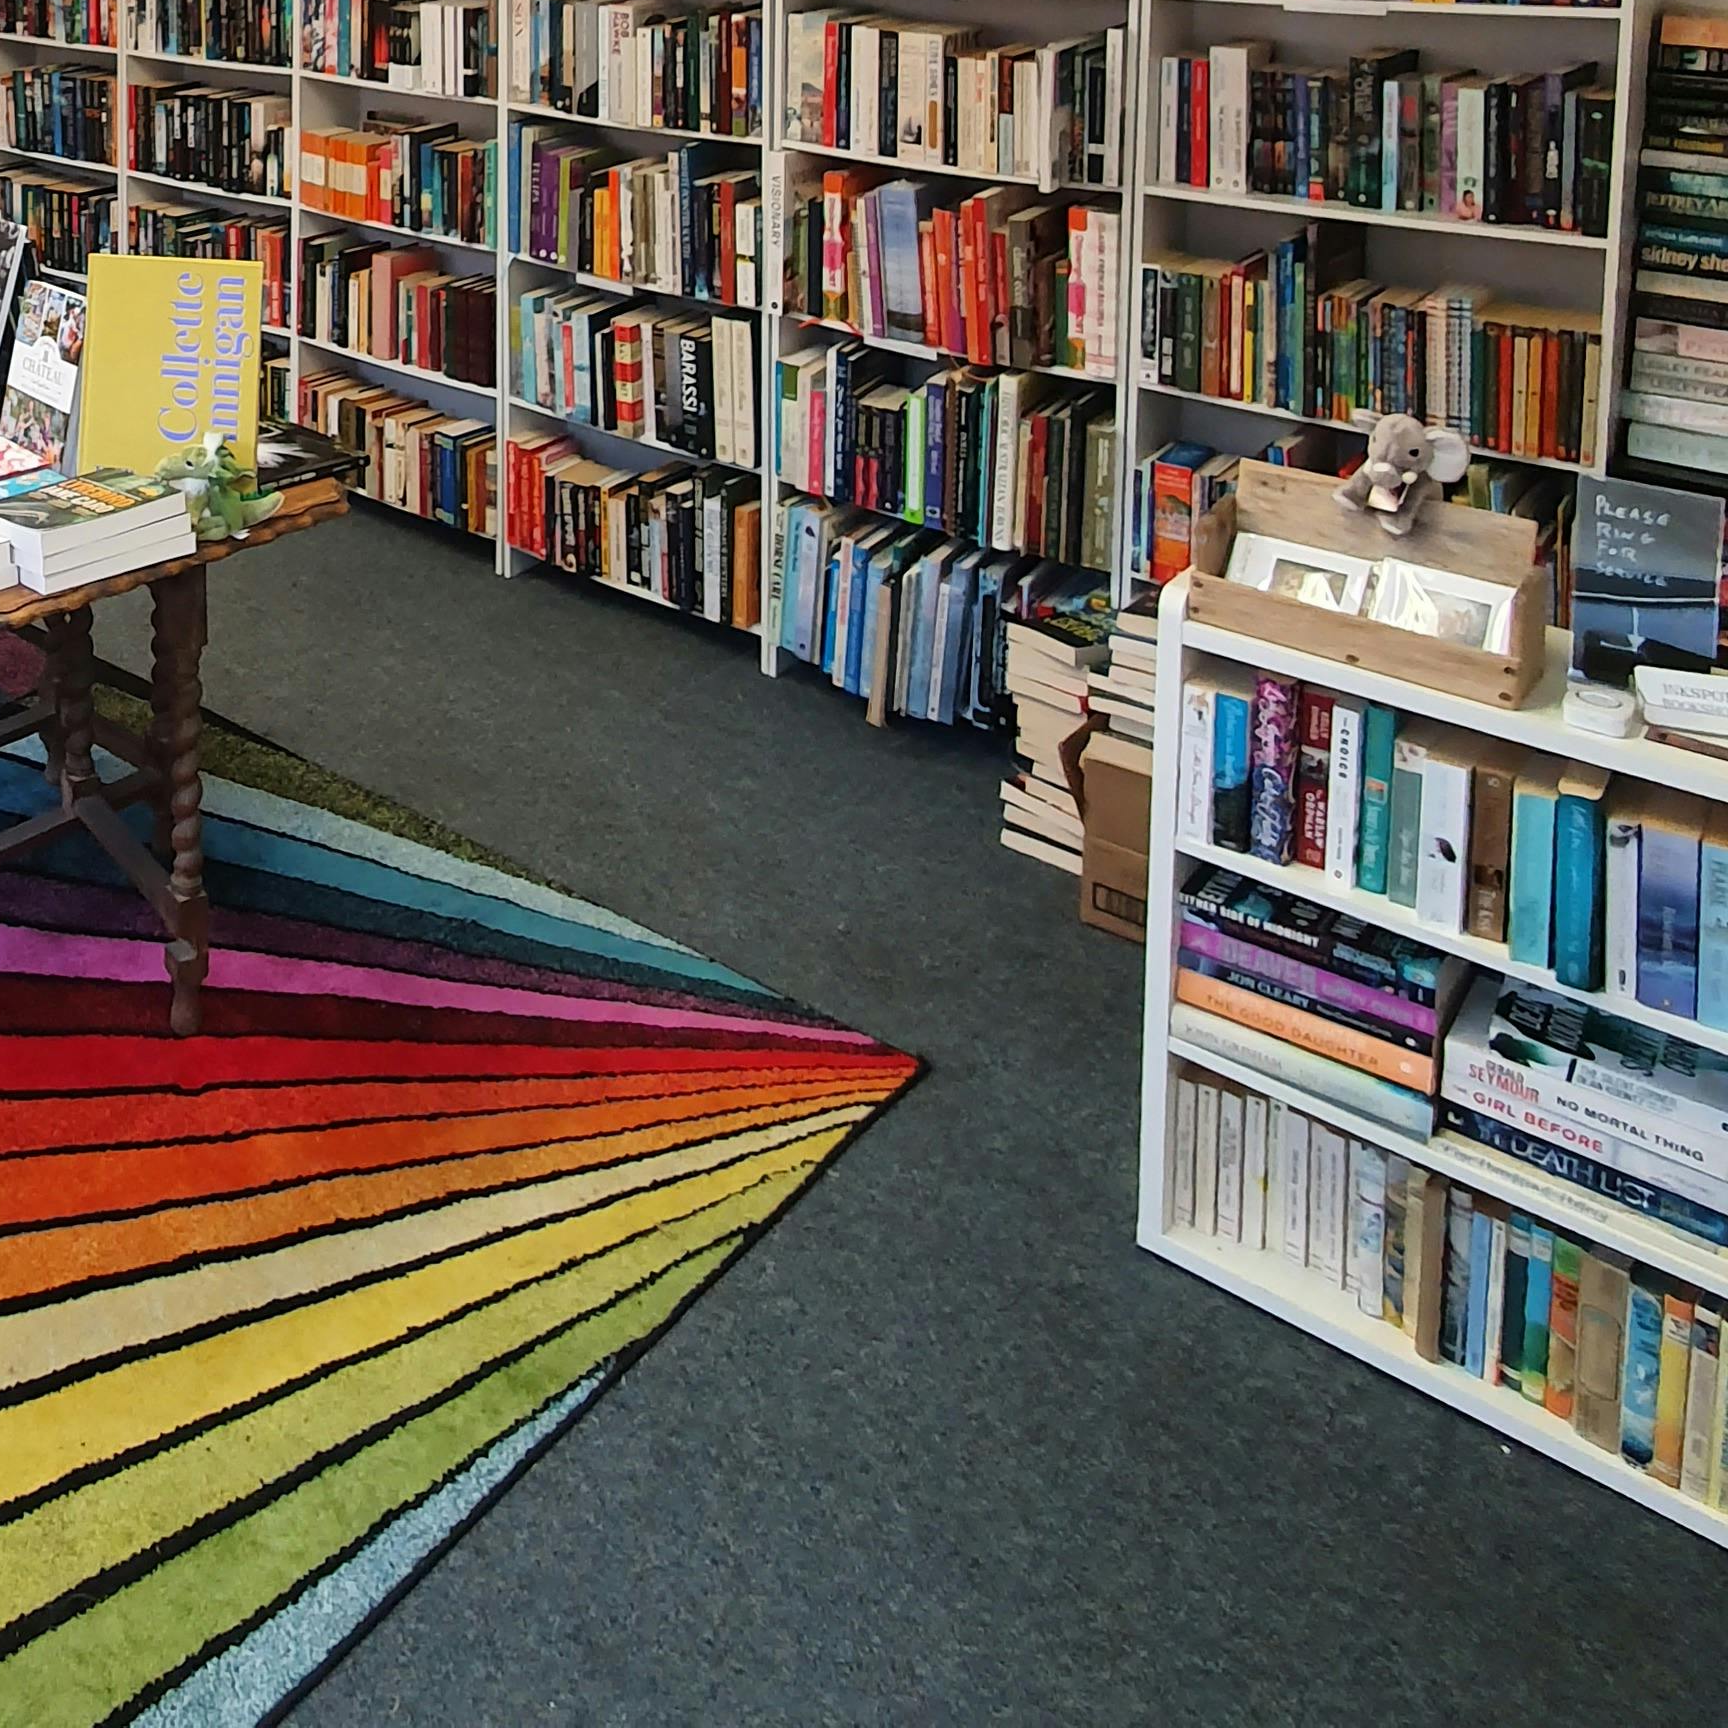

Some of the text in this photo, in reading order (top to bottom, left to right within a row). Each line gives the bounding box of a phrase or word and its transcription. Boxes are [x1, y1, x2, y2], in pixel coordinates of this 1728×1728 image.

[611, 12, 622, 55] HAWKE
[620, 12, 630, 38] BOB
[770, 175, 782, 248] VISIONARY
[1641, 245, 1699, 271] sidney
[157, 272, 204, 443] Collette
[680, 338, 698, 412] BARASSI
[1596, 494, 1670, 526] PLEASE
[1597, 522, 1655, 544] RING
[1597, 539, 1637, 563] FOR
[1338, 728, 1350, 779] CHOICE
[1179, 891, 1217, 914] EITHER
[1220, 905, 1245, 924] SIDE
[1263, 918, 1319, 949] MIDNIGHT
[1257, 982, 1310, 1009] CLEARY
[1206, 994, 1380, 1067] THE GOOD DAUGHTER
[1469, 1063, 1540, 1103] SEYMOUR
[1556, 1095, 1580, 1112] NO
[1584, 1107, 1648, 1140] MORTAL
[1654, 1134, 1705, 1162] THING
[1473, 1093, 1604, 1154] GIRL BEFORE
[1510, 1134, 1594, 1184] DEATH
[1600, 1171, 1656, 1210] LIST
